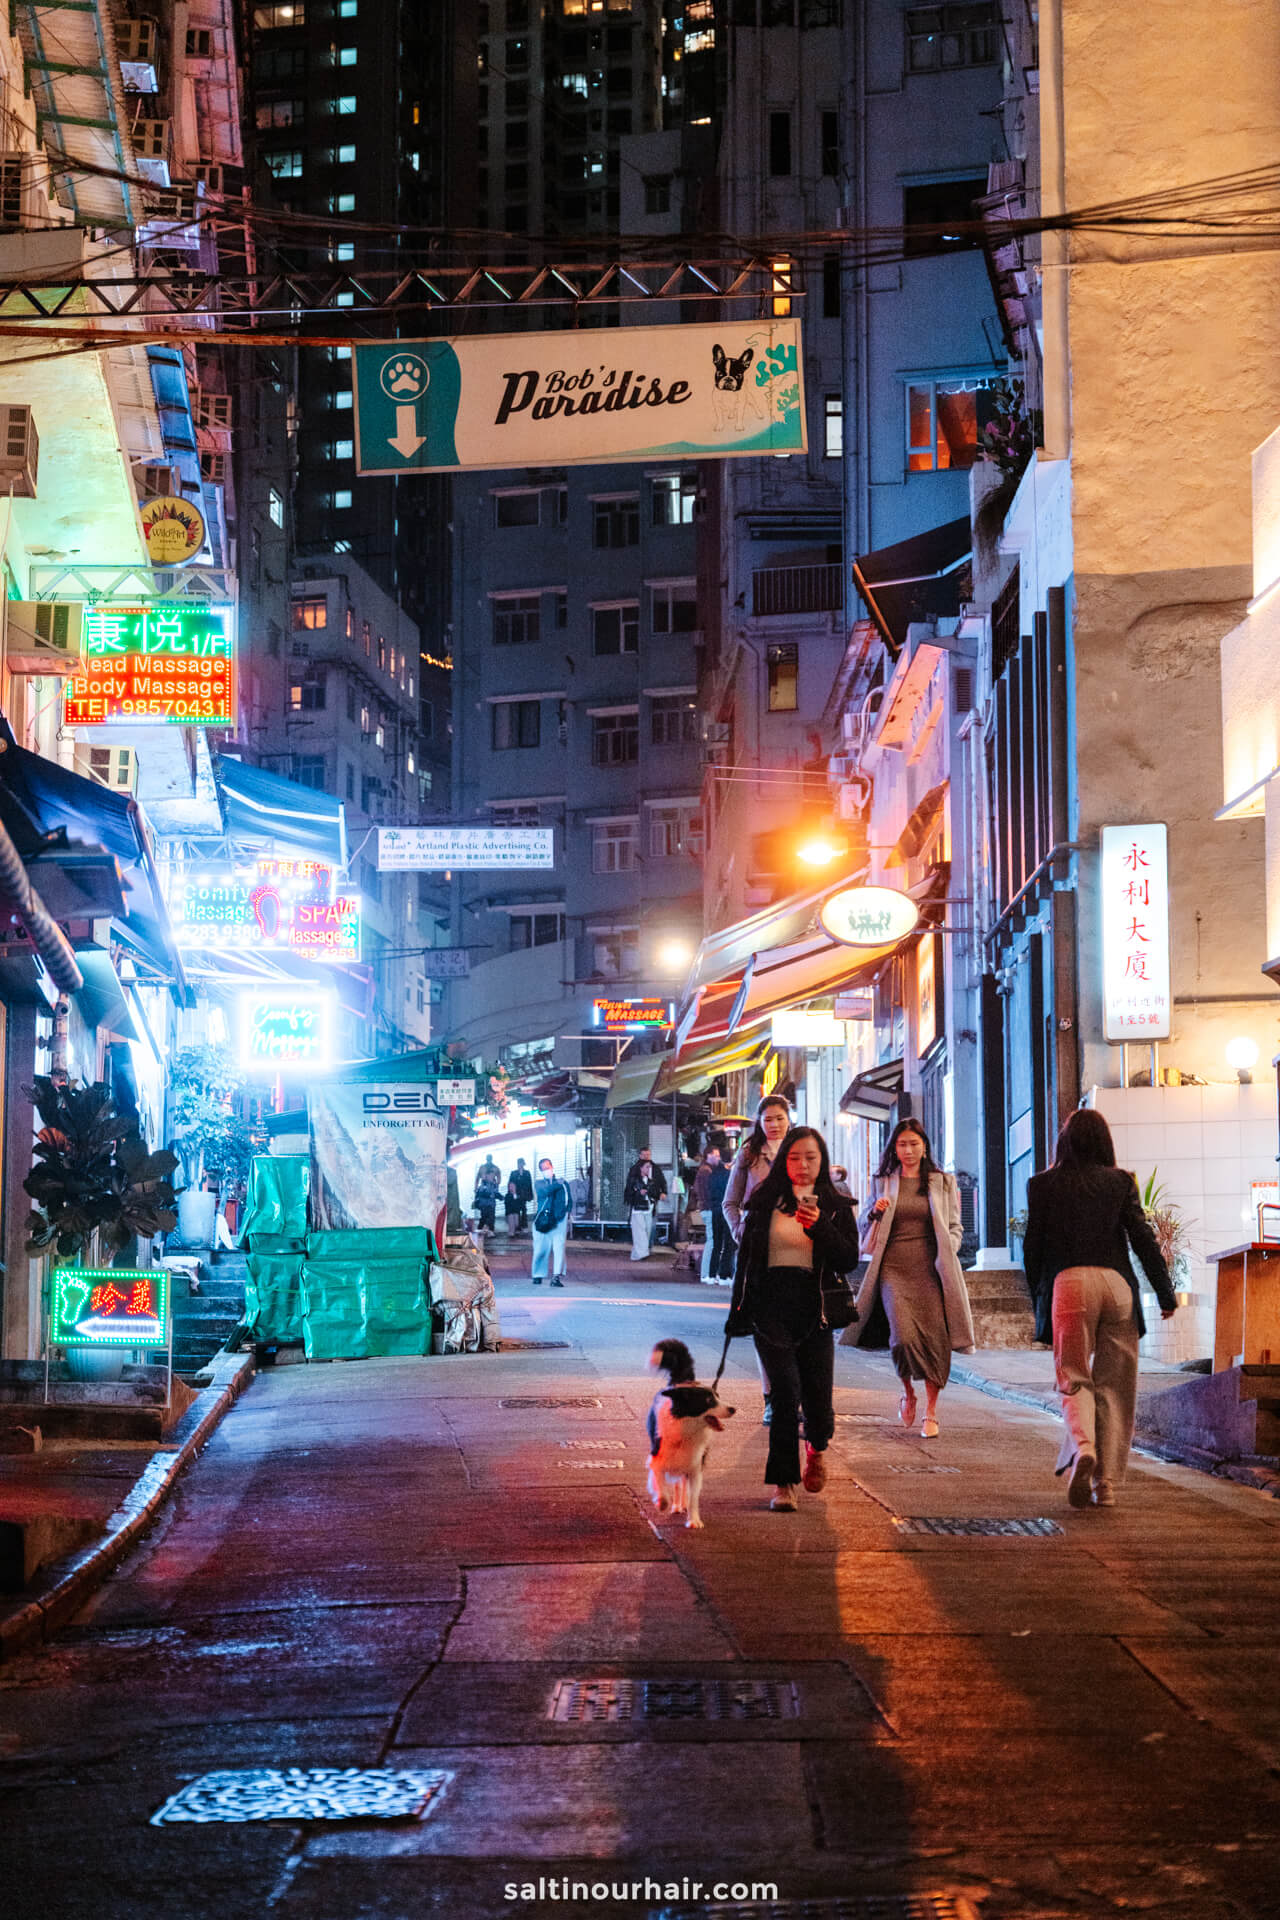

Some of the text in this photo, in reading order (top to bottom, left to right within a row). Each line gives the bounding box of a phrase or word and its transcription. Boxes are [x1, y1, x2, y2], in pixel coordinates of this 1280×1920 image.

[545, 365, 617, 394] Bob's
[494, 370, 693, 425] Paradise
[192, 633, 225, 657] 1/F
[89, 656, 226, 677] ead Massage
[74, 677, 225, 699] Body Massage
[416, 841, 449, 850] Artland
[451, 841, 479, 850] Plastic
[482, 841, 531, 851] Advertising
[533, 841, 548, 850] Co.
[183, 882, 251, 904] Comfy
[183, 901, 255, 924] Massage
[1121, 842, 1152, 981] 永利大廈
